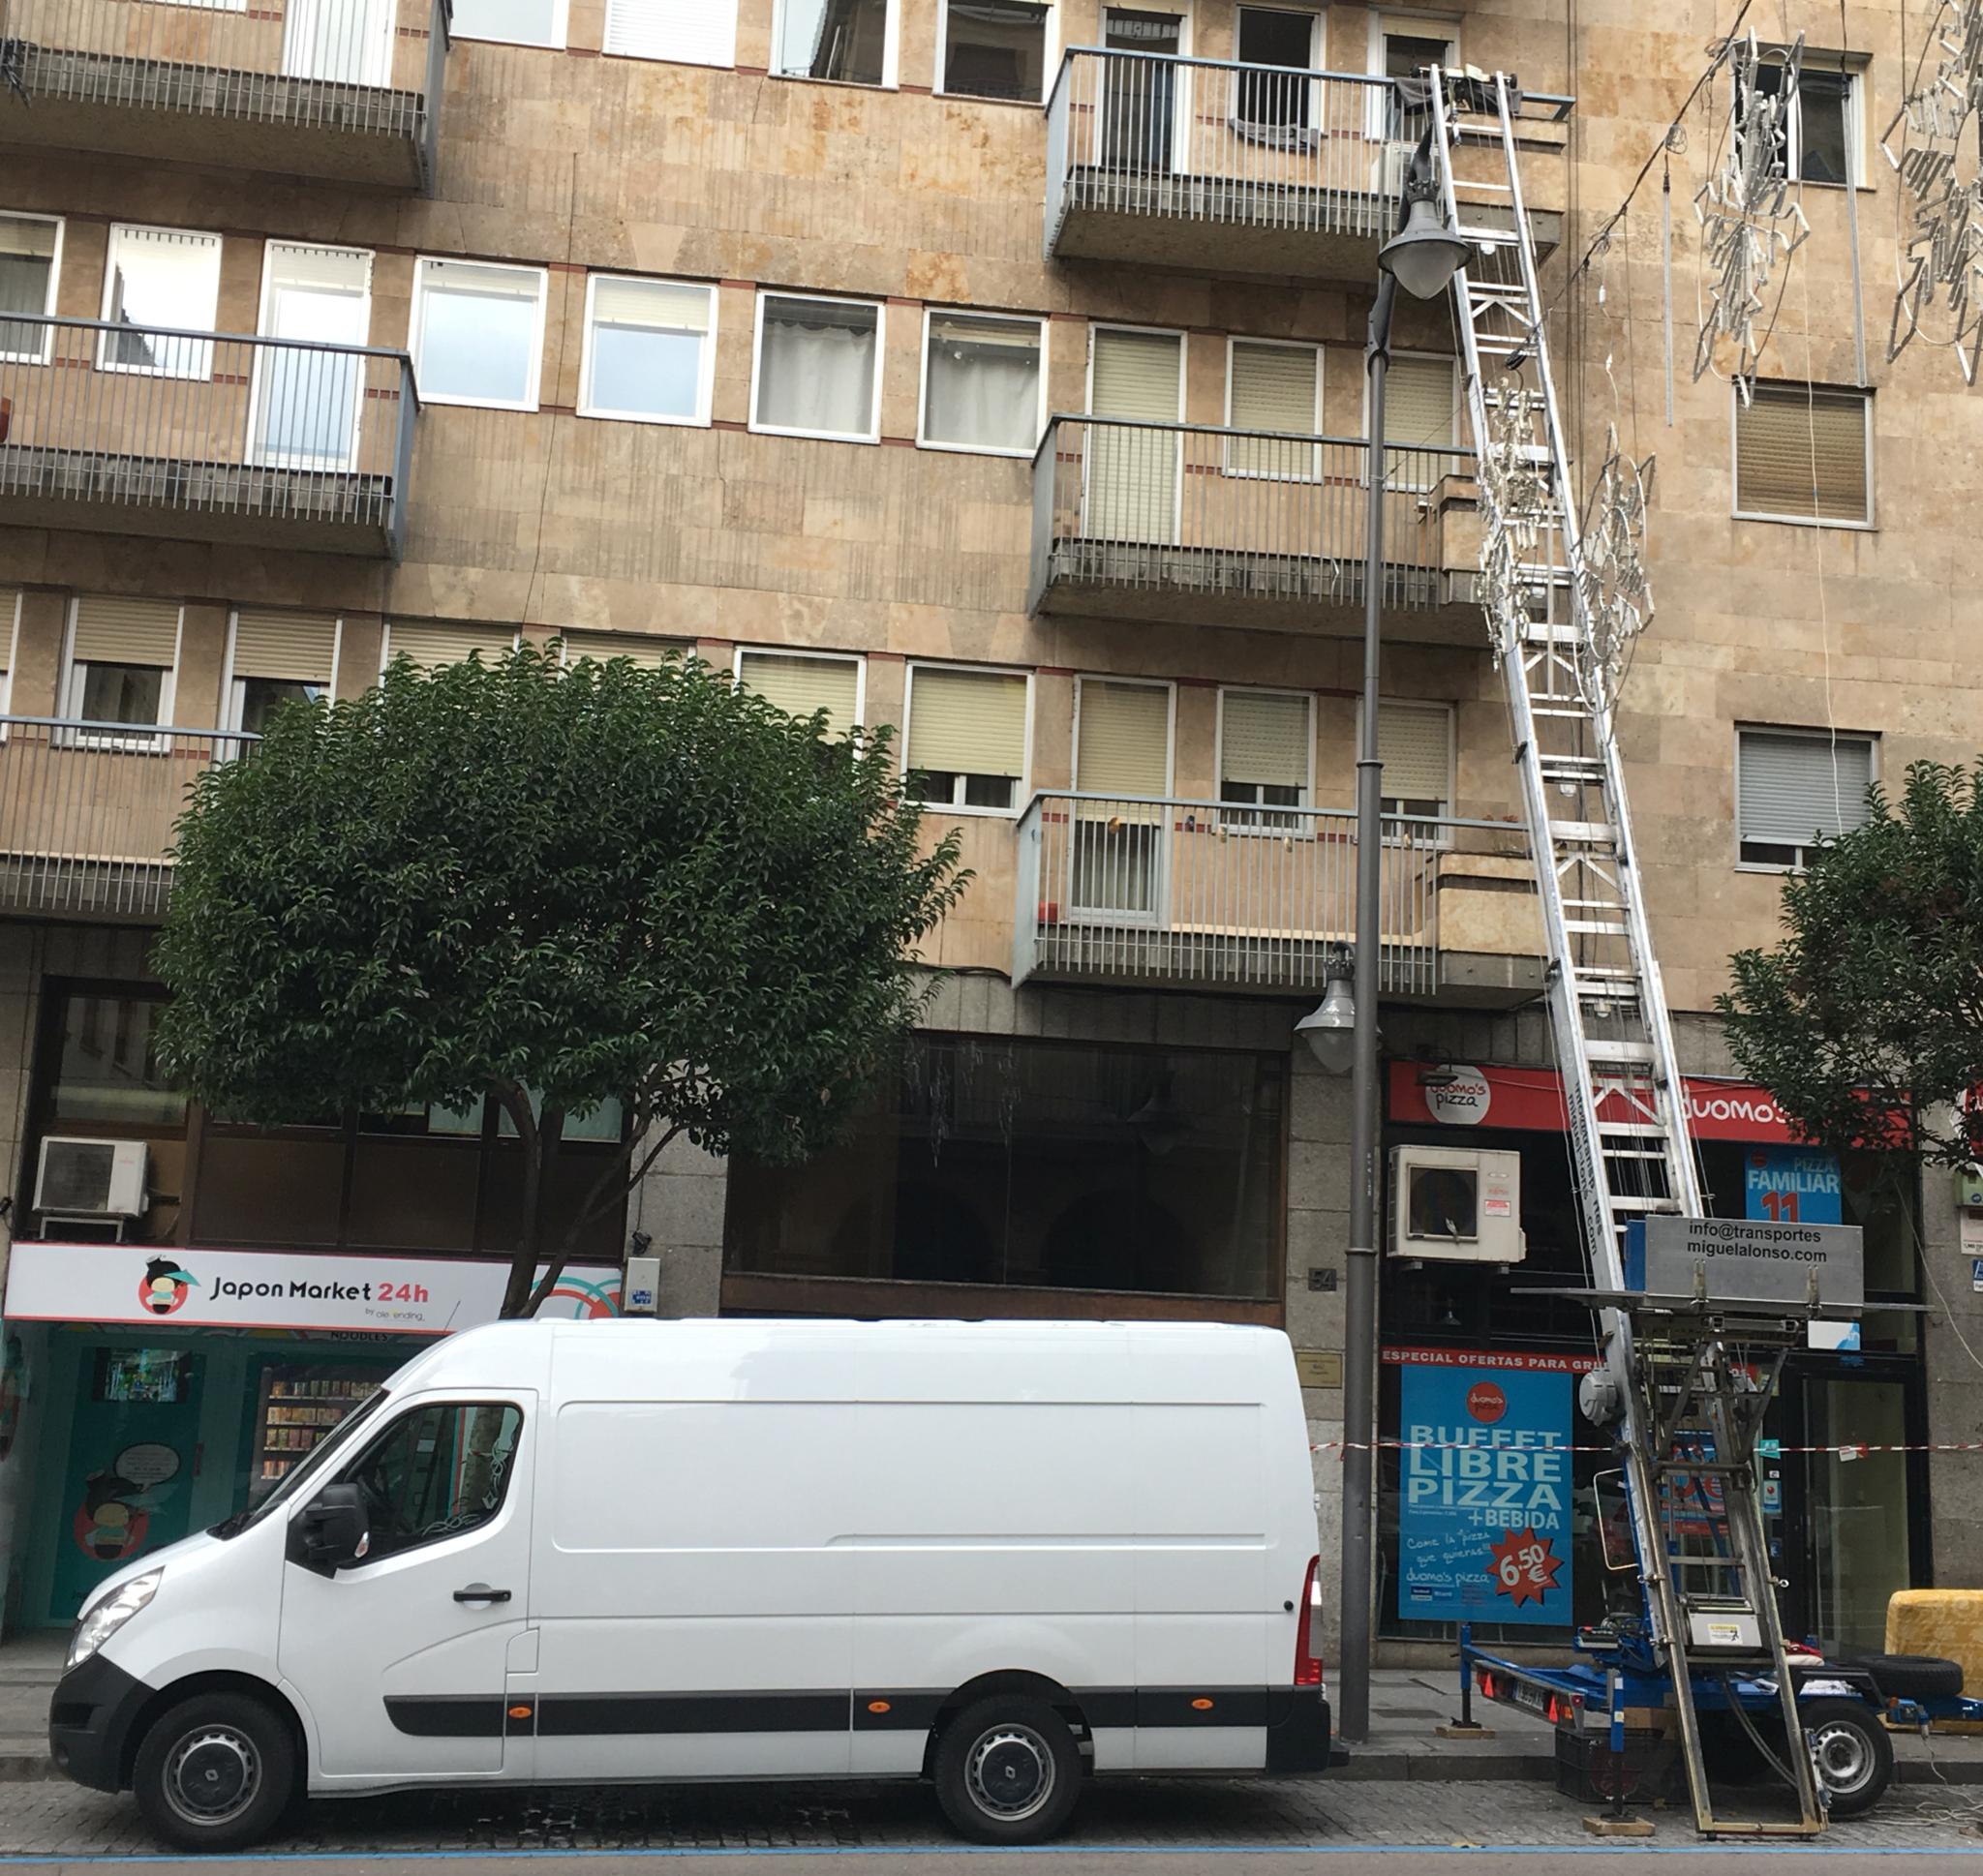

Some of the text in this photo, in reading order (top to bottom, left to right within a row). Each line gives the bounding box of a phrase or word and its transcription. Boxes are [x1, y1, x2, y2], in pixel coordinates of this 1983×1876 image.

[1436, 1093, 1479, 1109] pizza
[1794, 1157, 1835, 1172] PIZZA
[1748, 1169, 1840, 1194] FAMILIAR
[1761, 1192, 1798, 1223] 11
[1689, 1221, 1821, 1243] info@transportes
[1687, 1240, 1827, 1262] miguelalonso.com
[209, 1277, 429, 1303] Japon Market 24h
[1310, 1270, 1333, 1288] 54
[330, 1331, 388, 1342] NOODLES
[1382, 1350, 1453, 1363] ESPECIAL
[1458, 1354, 1523, 1367] OFERTAS
[1528, 1358, 1567, 1369] PARA
[1410, 1424, 1562, 1448] BUFFET
[1409, 1447, 1562, 1483] LIBRE
[1408, 1477, 1563, 1511] PIZZA
[1406, 1567, 1491, 1587] duomo's pizza
